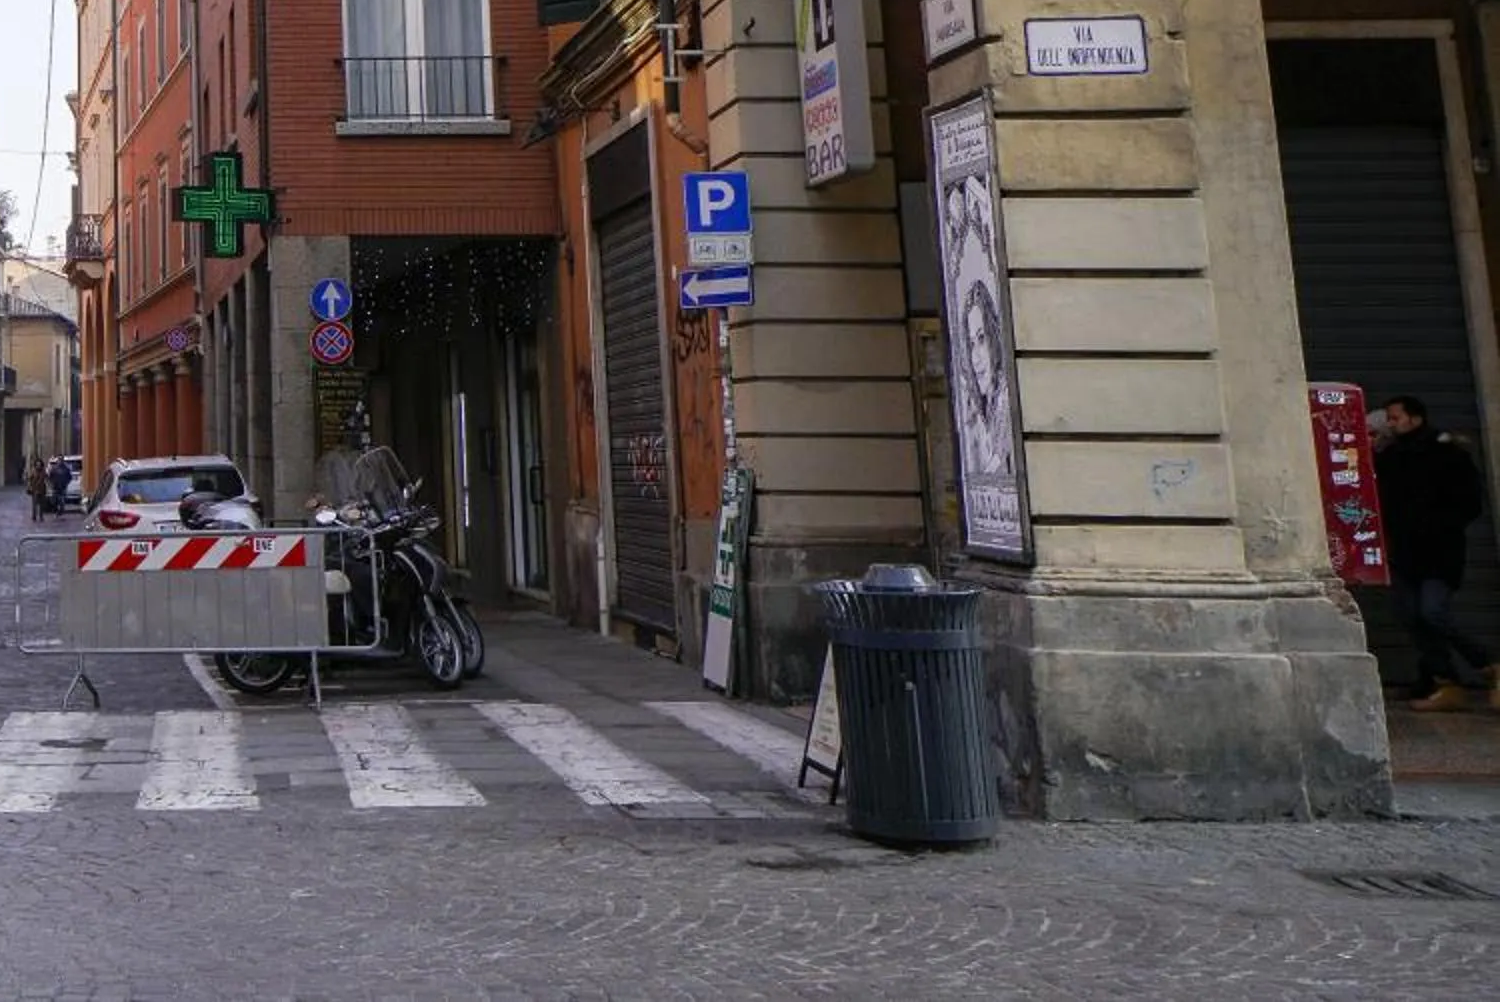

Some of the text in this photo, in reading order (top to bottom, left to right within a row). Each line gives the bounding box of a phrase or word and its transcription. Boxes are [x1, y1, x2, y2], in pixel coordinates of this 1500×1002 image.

[1074, 25, 1093, 43] VIA
[807, 134, 845, 178] BAR
[697, 180, 735, 227] P
